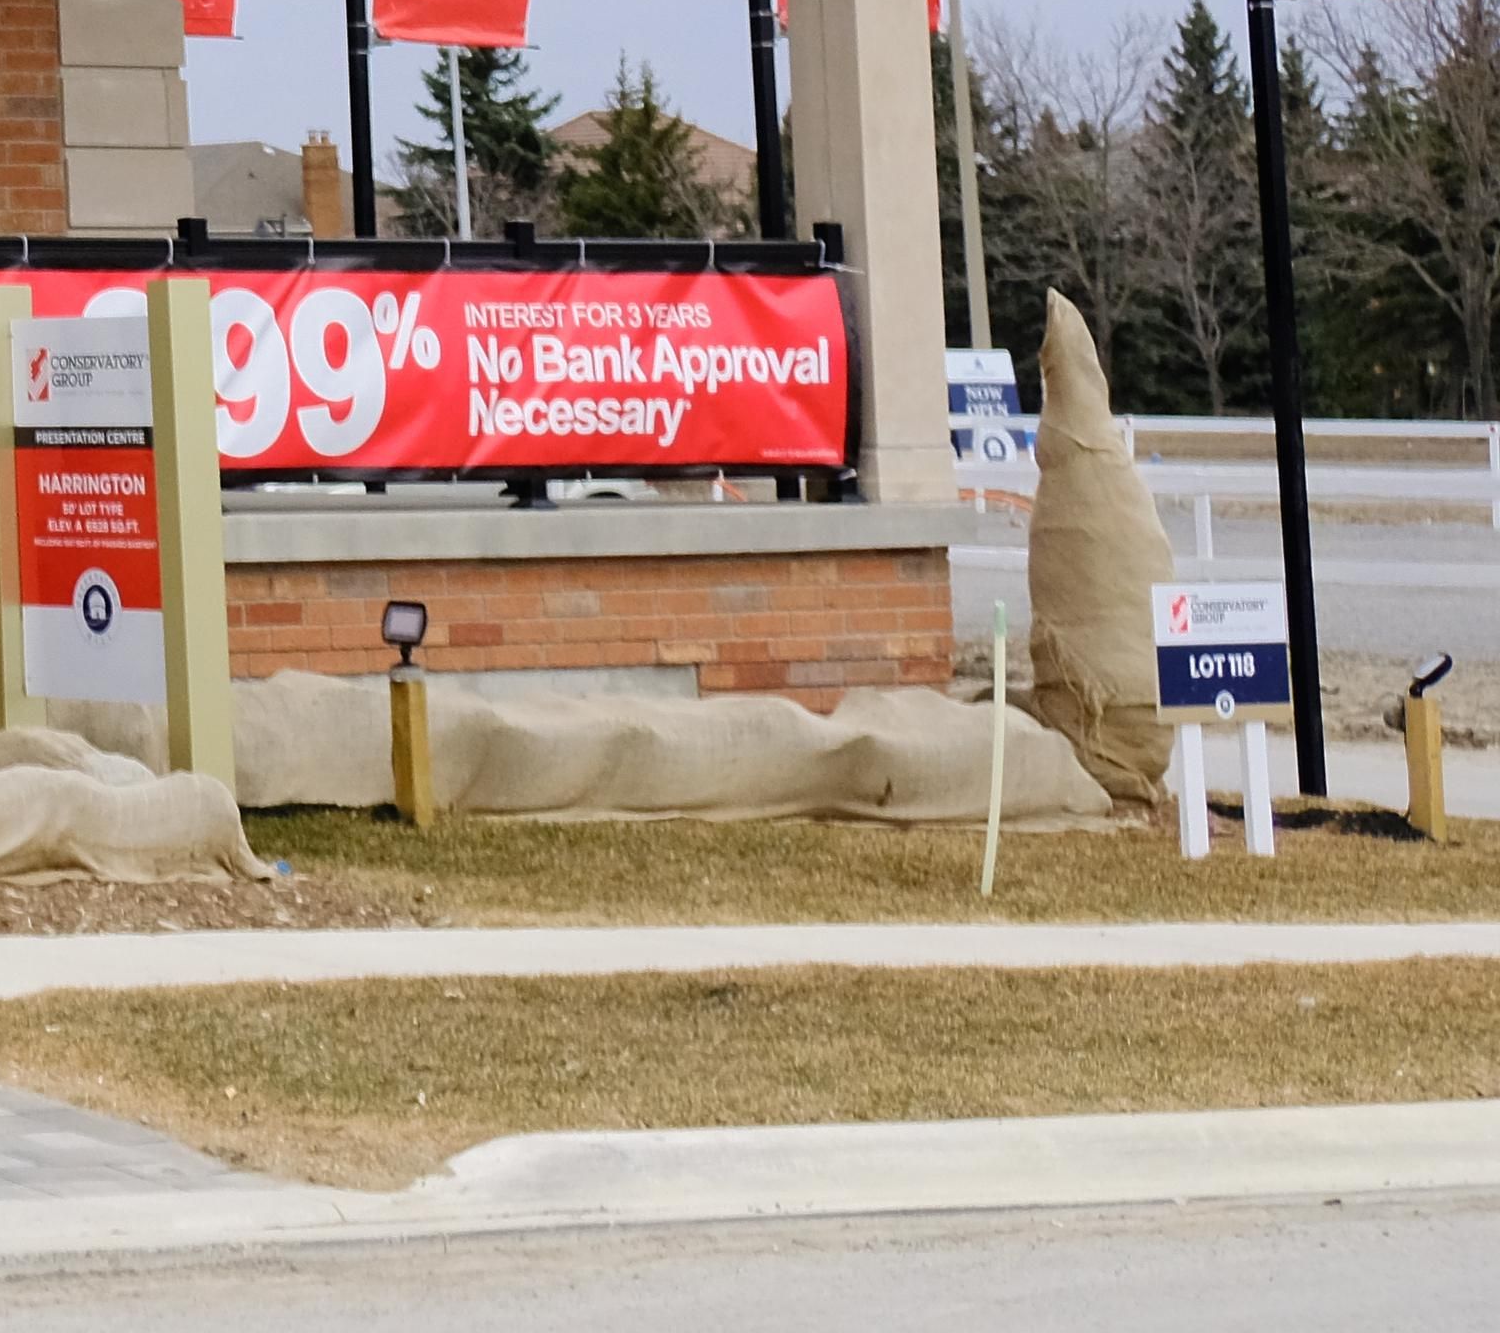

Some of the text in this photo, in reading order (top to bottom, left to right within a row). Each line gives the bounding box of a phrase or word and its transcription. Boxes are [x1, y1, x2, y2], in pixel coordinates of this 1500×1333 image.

[464, 302, 712, 328] INTEREST FOR 3 YEARS
[51, 354, 145, 370] CONSERVATORY
[467, 334, 830, 394] No Bank Approval
[52, 373, 92, 387] GROUP
[964, 384, 1003, 400] NOW
[35, 430, 145, 445] PRESENTATION CENTRE
[38, 473, 146, 495] HARRINGTON
[79, 501, 97, 516] LOT
[99, 501, 124, 516] TYPE
[75, 519, 83, 533] A
[1192, 613, 1225, 624] GROUP
[1189, 651, 1256, 679] LOT 118
